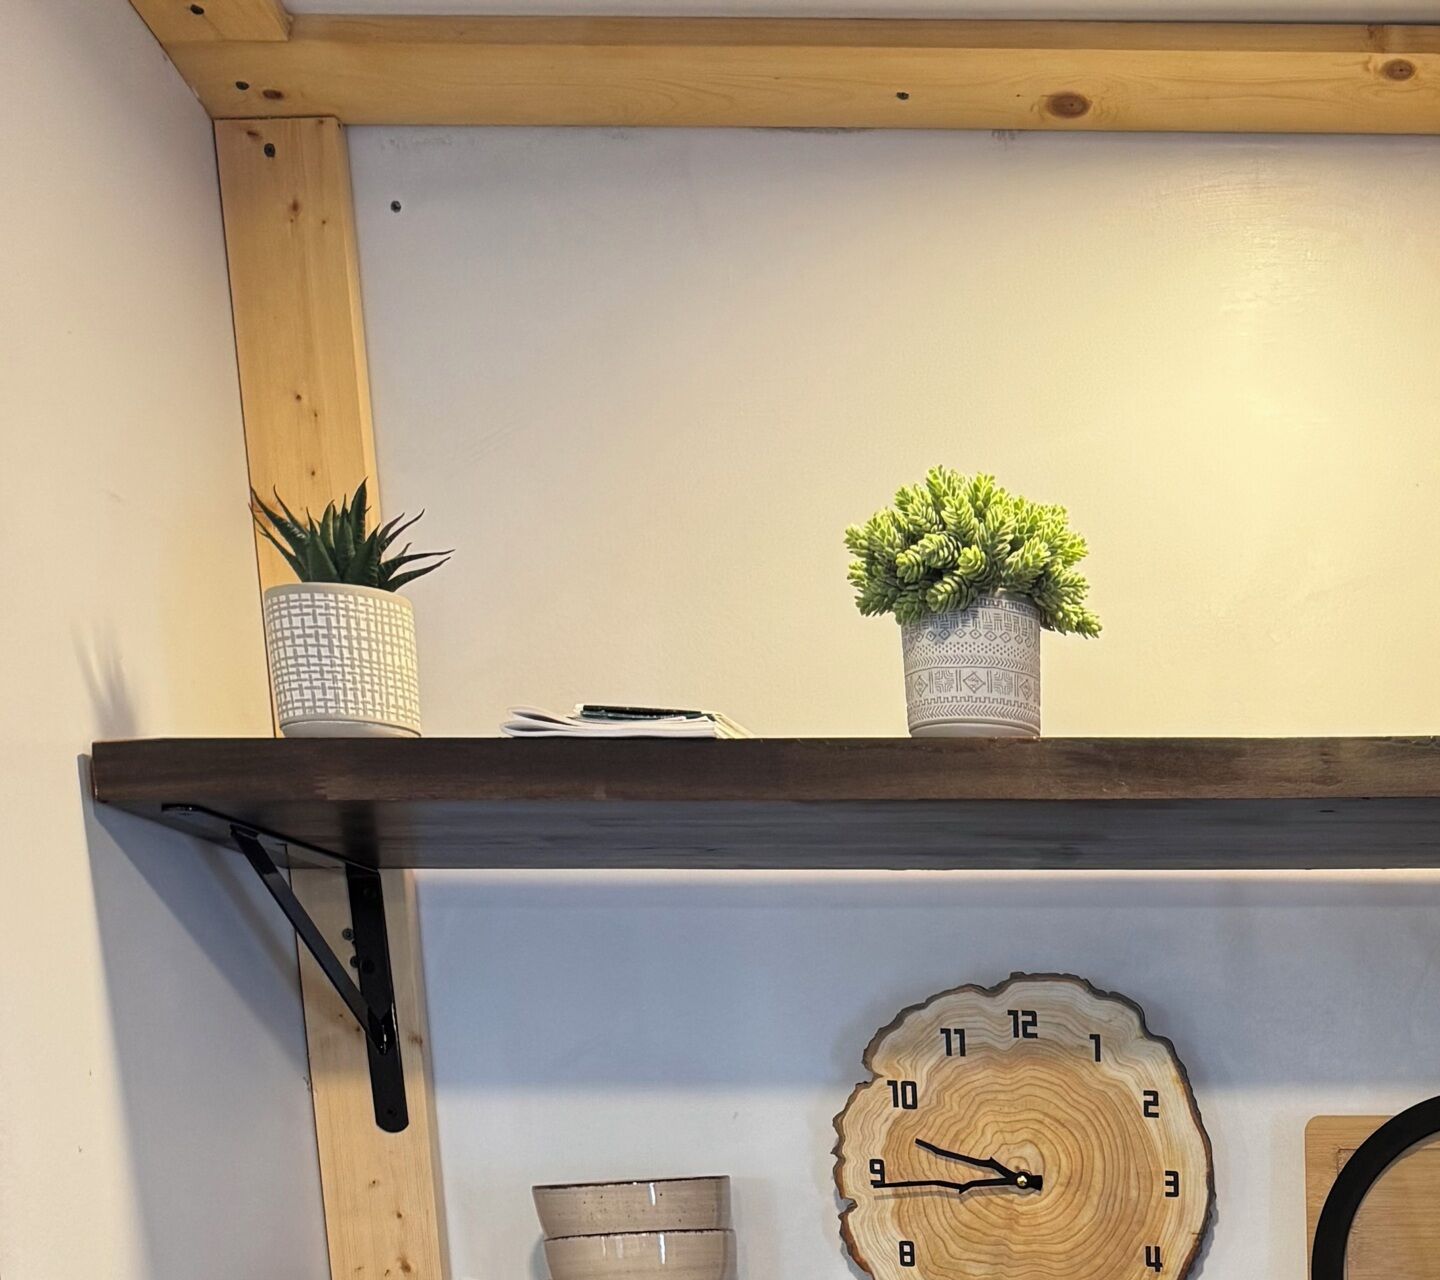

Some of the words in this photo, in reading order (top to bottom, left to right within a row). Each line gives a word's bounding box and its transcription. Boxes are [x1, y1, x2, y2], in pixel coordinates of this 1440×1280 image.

[1007, 1009, 1039, 1039] 12
[939, 1027, 967, 1057] 11
[1089, 1033, 1101, 1063] 1
[886, 1079, 918, 1110] 10
[1143, 1090, 1160, 1119] 2
[869, 1158, 885, 1187] 9
[1164, 1170, 1180, 1198] 3
[898, 1240, 916, 1267] 8
[1145, 1245, 1164, 1273] 4
